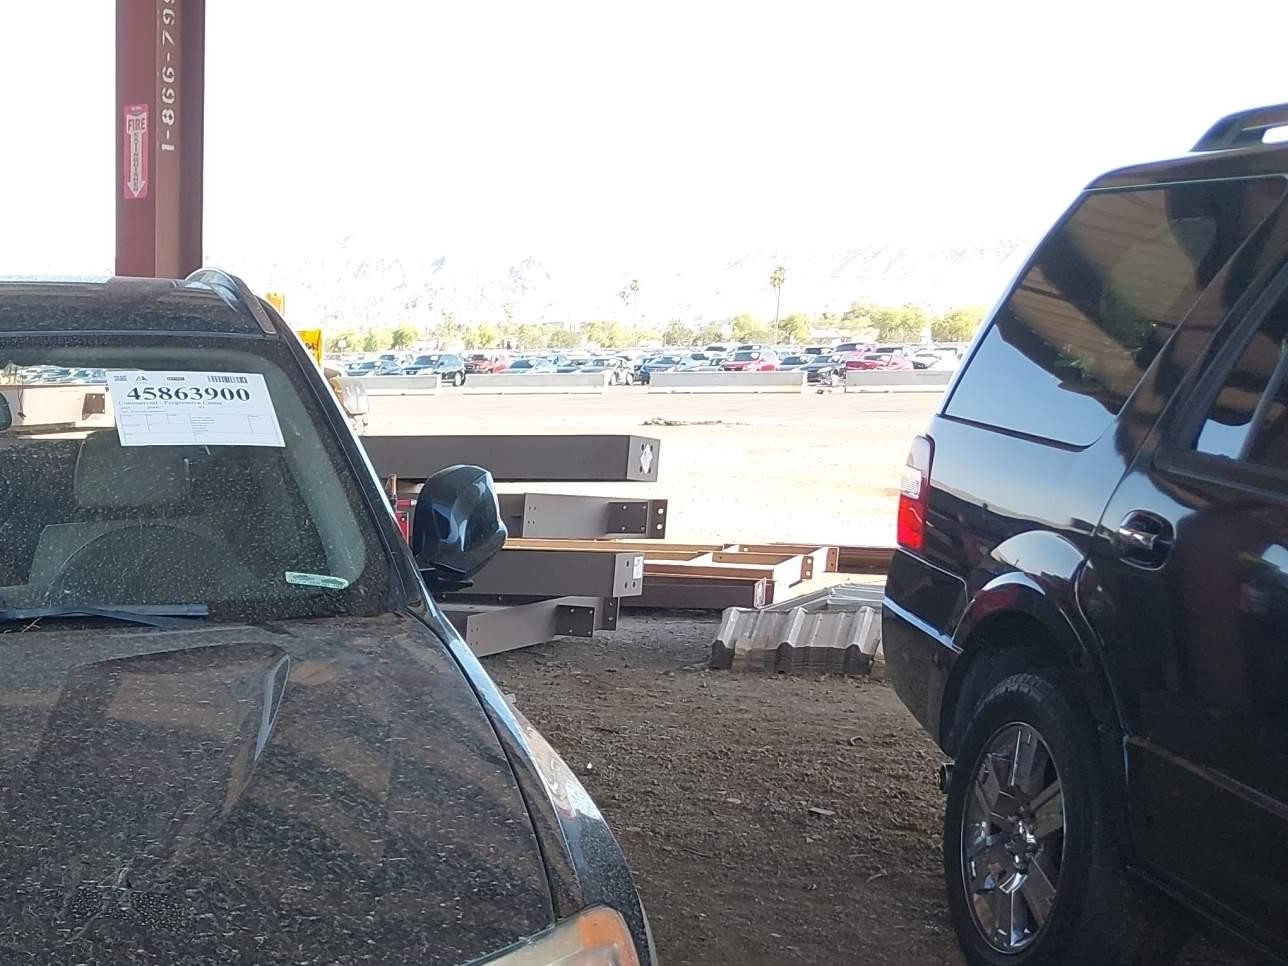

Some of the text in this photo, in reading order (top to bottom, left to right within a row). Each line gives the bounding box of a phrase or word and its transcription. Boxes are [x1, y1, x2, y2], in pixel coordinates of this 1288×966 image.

[162, 0, 175, 150] 1-866-79
[128, 118, 146, 132] FIRE
[127, 387, 250, 401] 45863900
